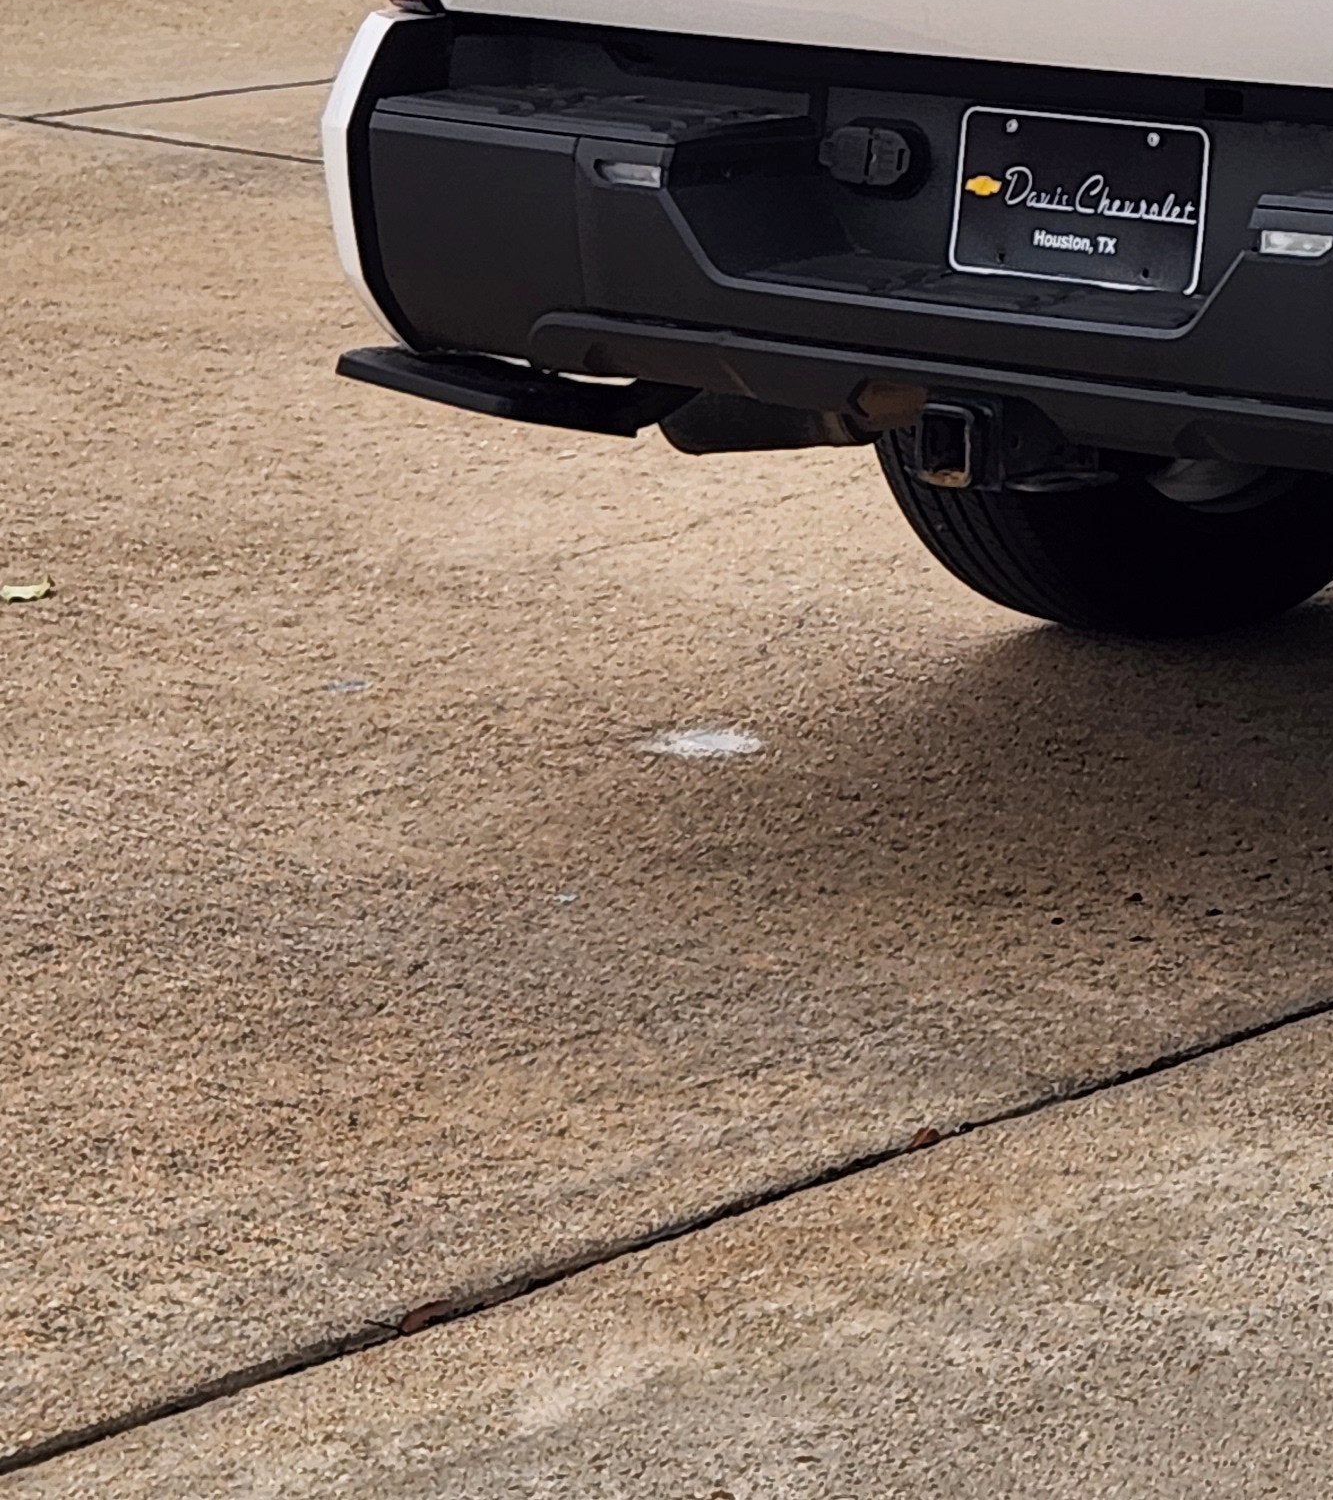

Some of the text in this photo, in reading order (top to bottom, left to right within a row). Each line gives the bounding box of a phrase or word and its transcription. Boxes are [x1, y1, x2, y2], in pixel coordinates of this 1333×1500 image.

[1003, 165, 1198, 226] Davis Chevrolet
[1032, 229, 1118, 255] Houston, TX
